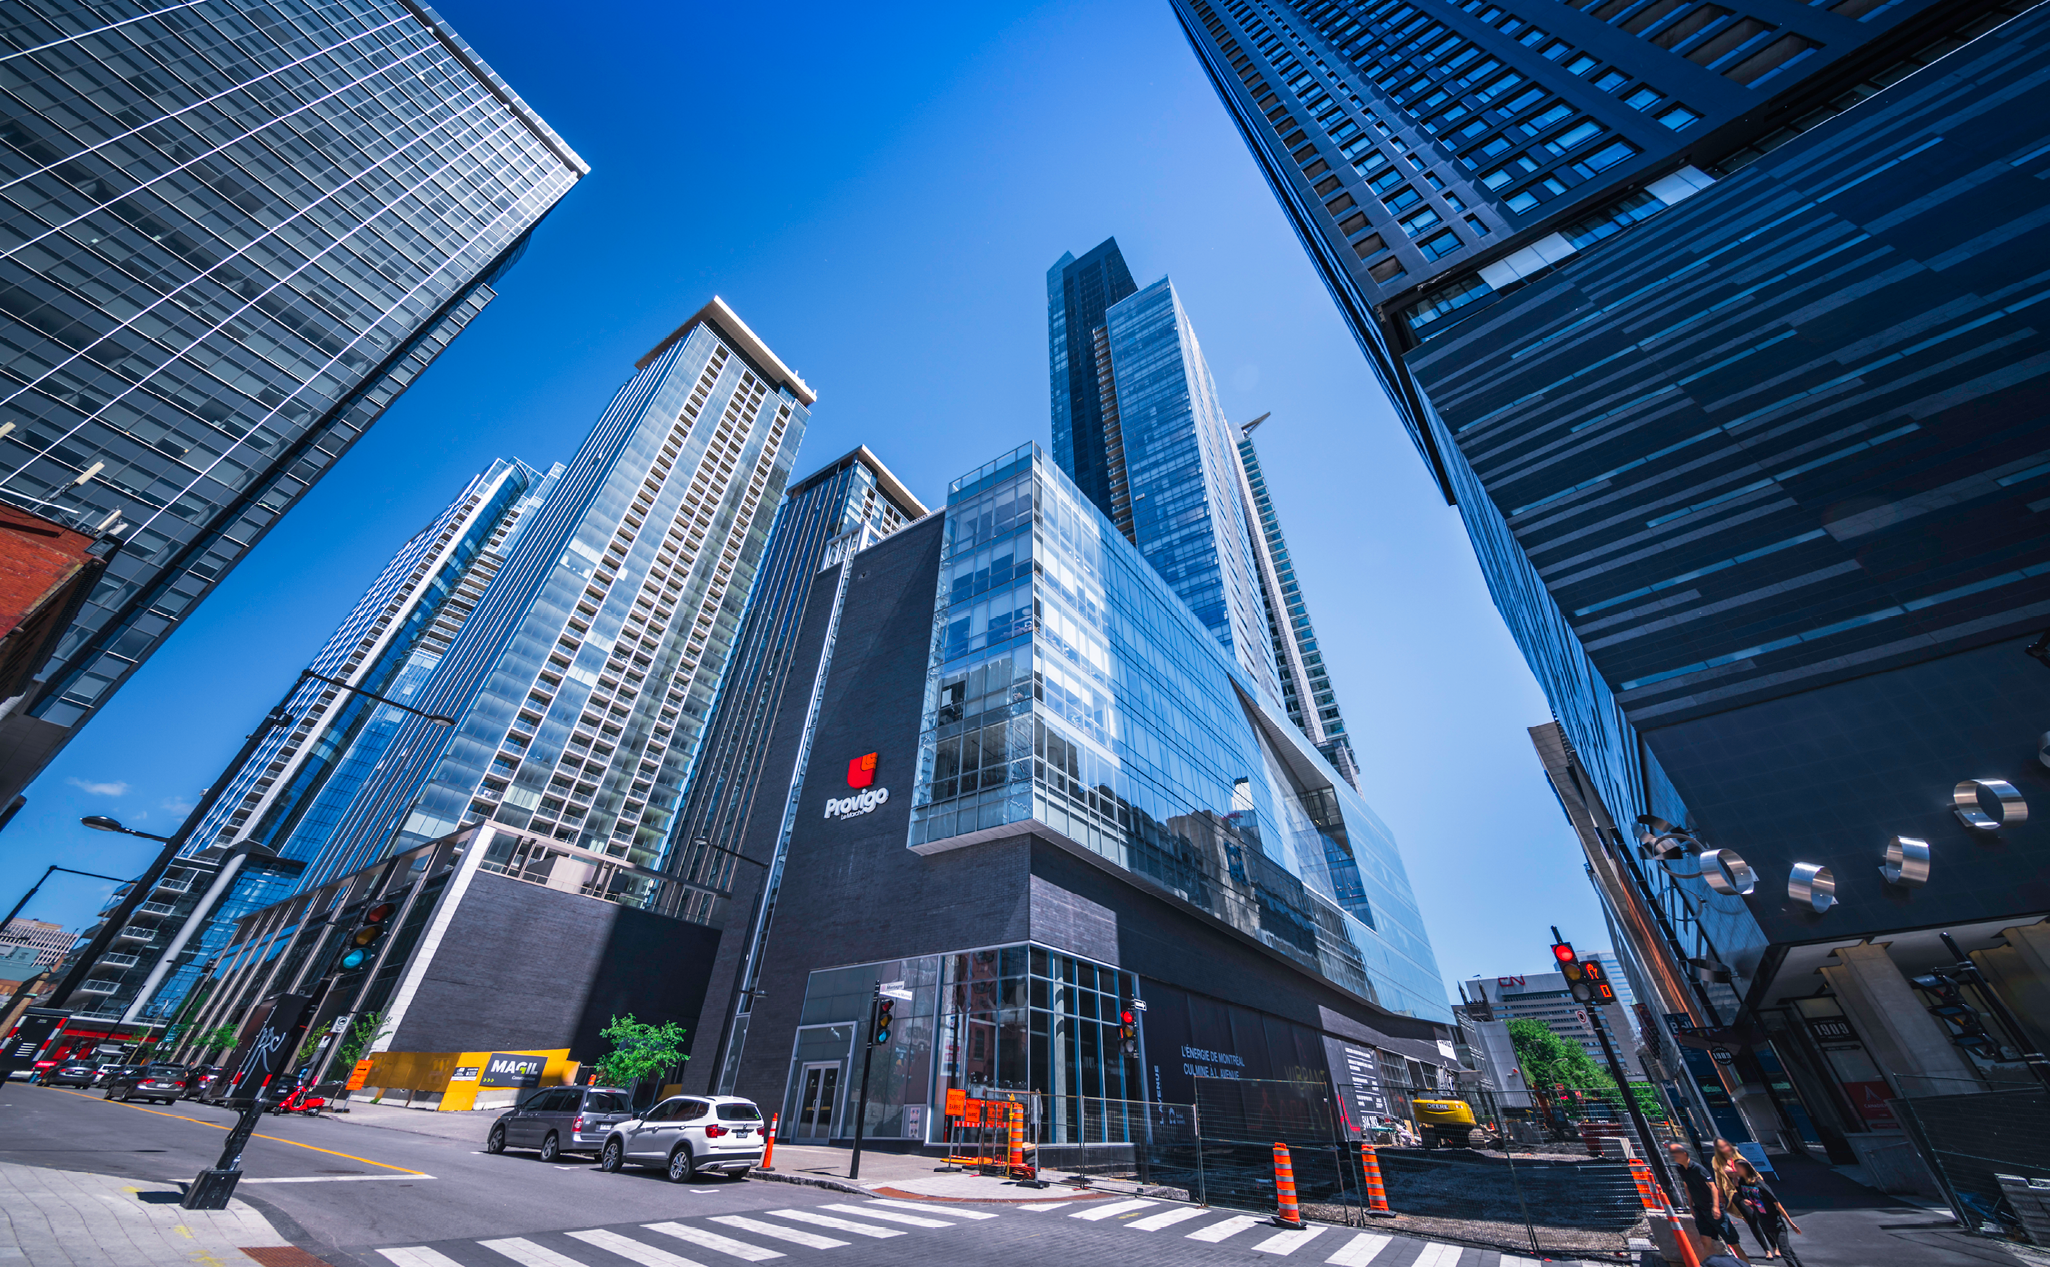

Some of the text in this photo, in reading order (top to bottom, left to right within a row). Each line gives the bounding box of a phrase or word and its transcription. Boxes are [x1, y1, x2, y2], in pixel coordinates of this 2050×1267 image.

[824, 787, 890, 819] Provigo
[1498, 975, 1526, 987] CN
[1599, 984, 1613, 998] 0
[1813, 1022, 1850, 1036] 1909
[1181, 1043, 1245, 1067] L'ÉNERGIE DE MONTRÉAL
[490, 1060, 538, 1075] MAGIL
[1183, 1063, 1209, 1077] CULMINE
[1284, 1065, 1325, 1092] VIBRANT
